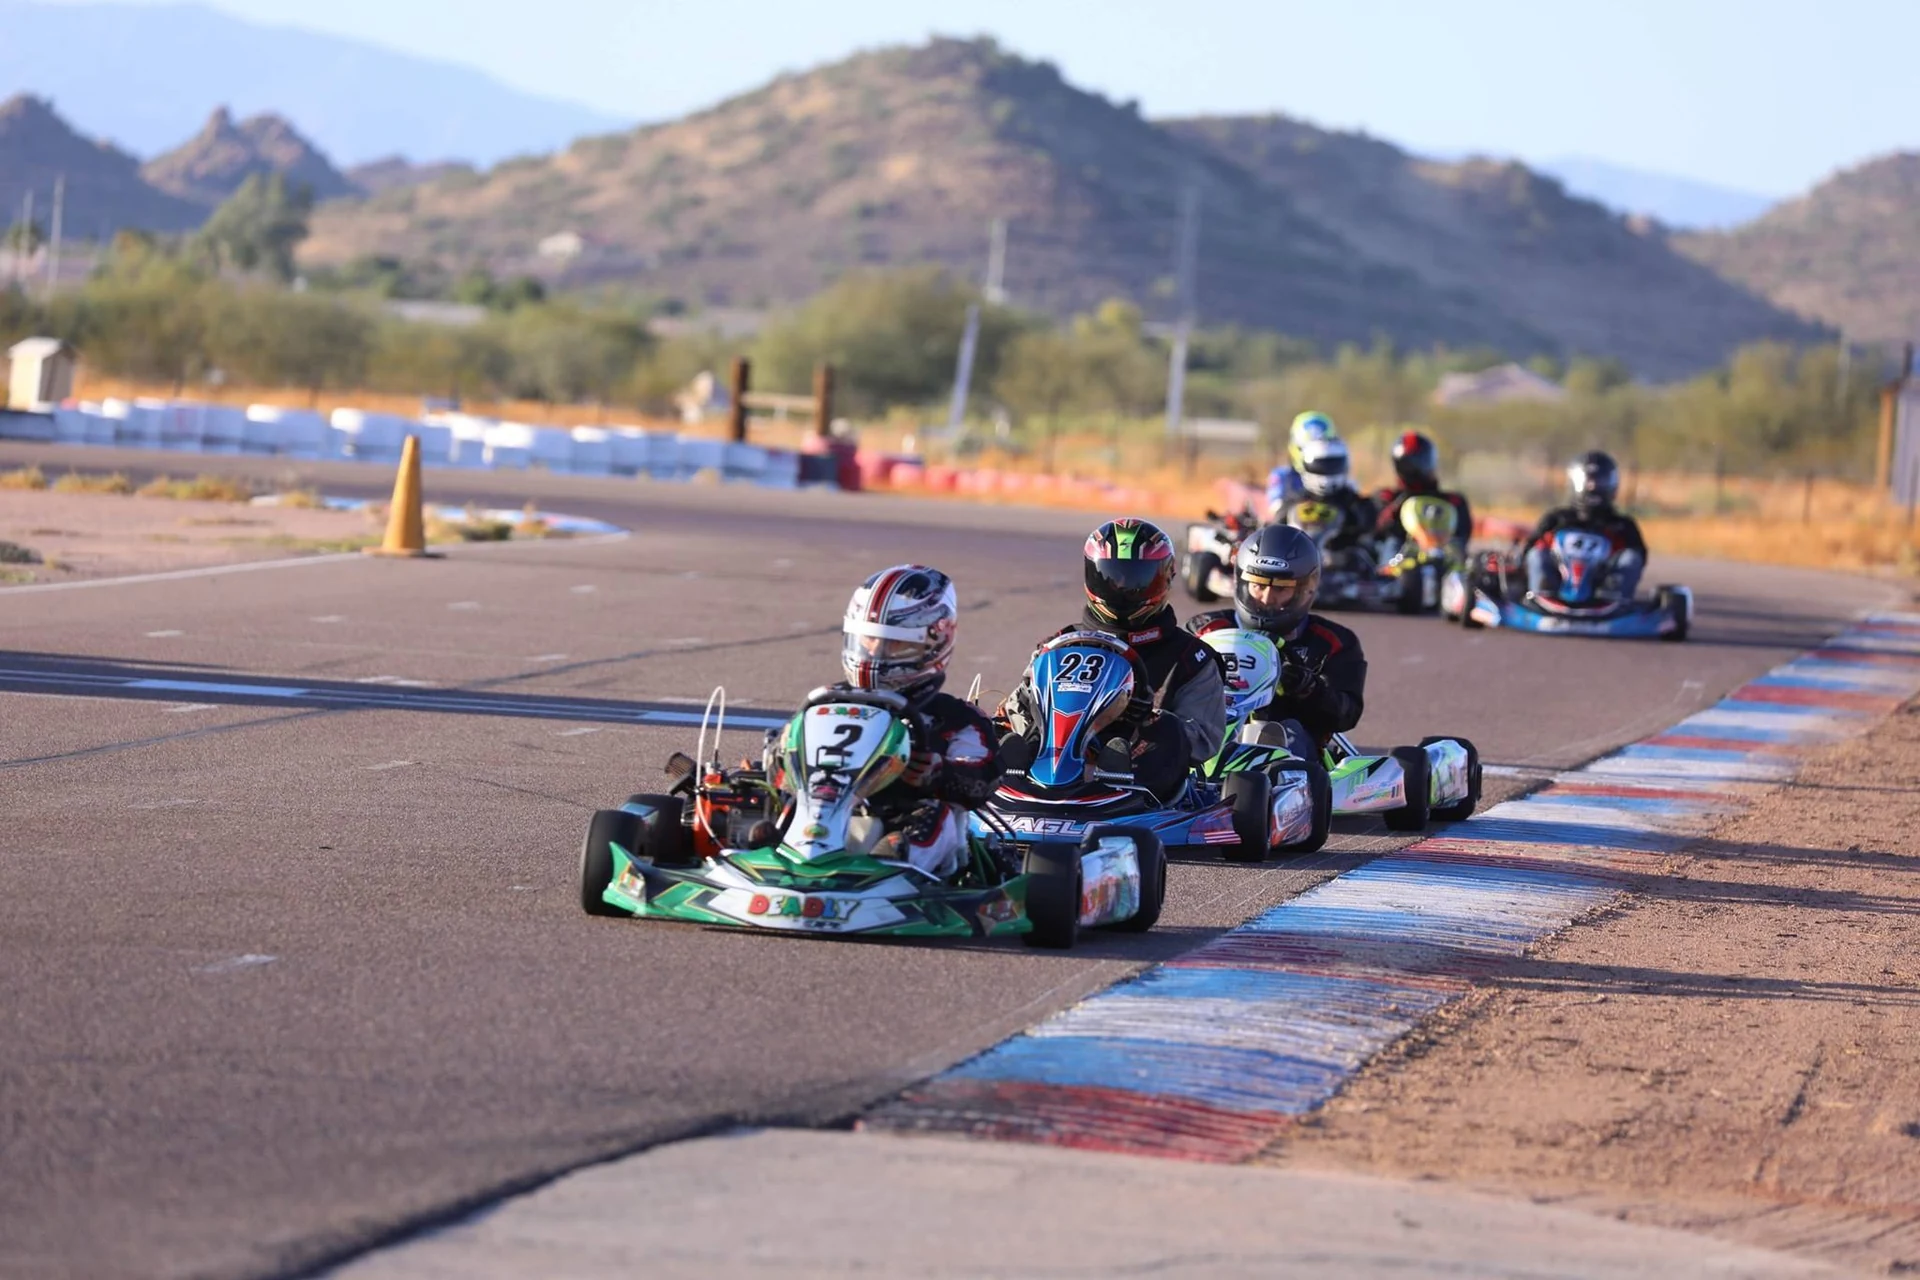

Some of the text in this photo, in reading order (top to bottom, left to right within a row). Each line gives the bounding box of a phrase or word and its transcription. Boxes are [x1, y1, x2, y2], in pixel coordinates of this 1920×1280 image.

[1054, 652, 1105, 683] 23
[825, 723, 863, 756] 2
[747, 894, 861, 921] DEADLY
